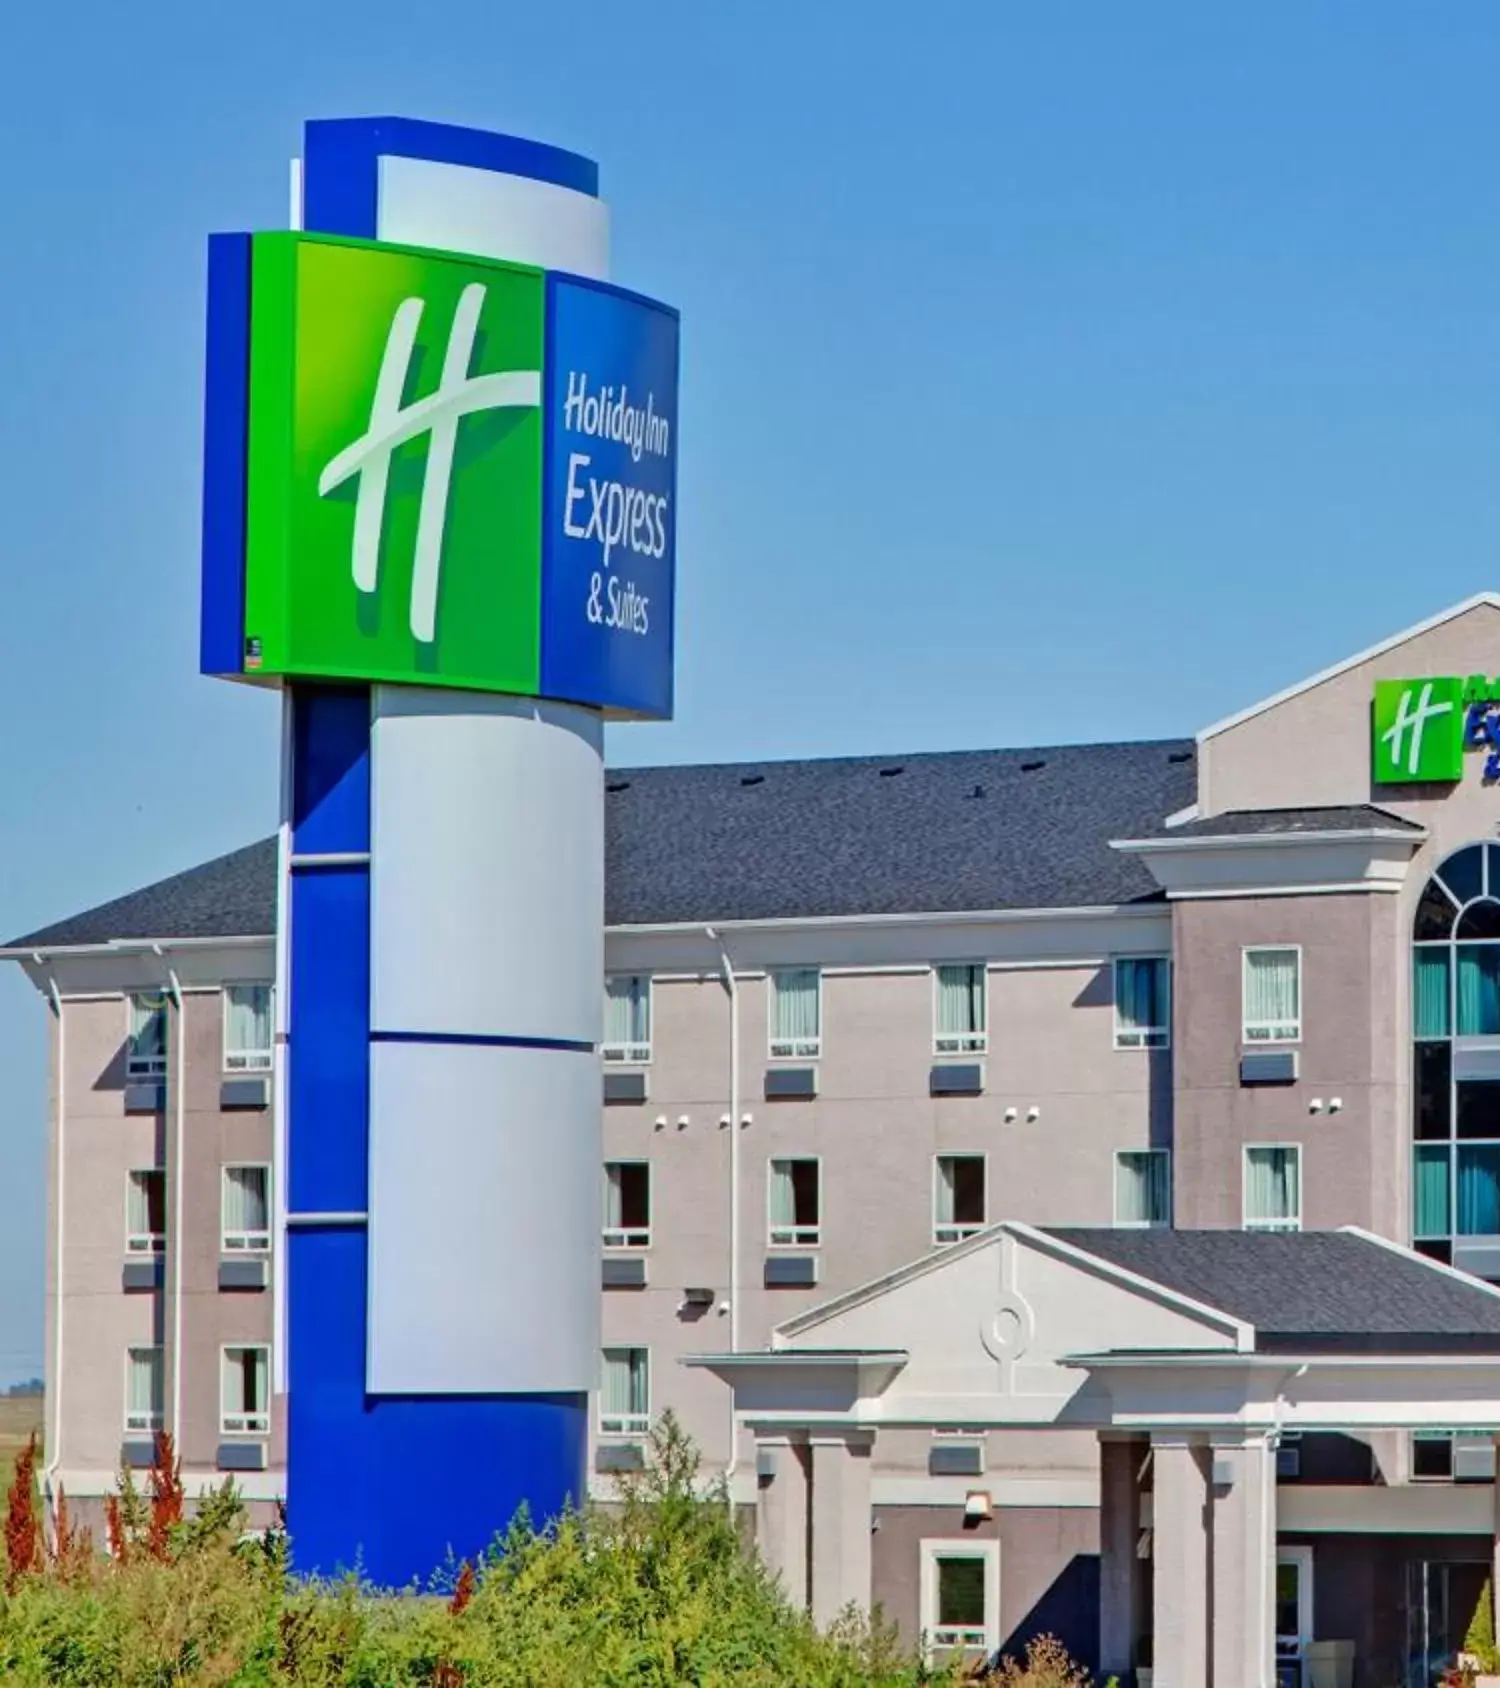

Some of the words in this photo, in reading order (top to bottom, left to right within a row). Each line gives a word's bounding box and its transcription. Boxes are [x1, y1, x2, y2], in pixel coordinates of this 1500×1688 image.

[563, 370, 645, 463] Holiday
[645, 391, 669, 458] Inn
[563, 452, 667, 567] Express
[587, 571, 603, 625] &
[605, 575, 650, 635] Suites
